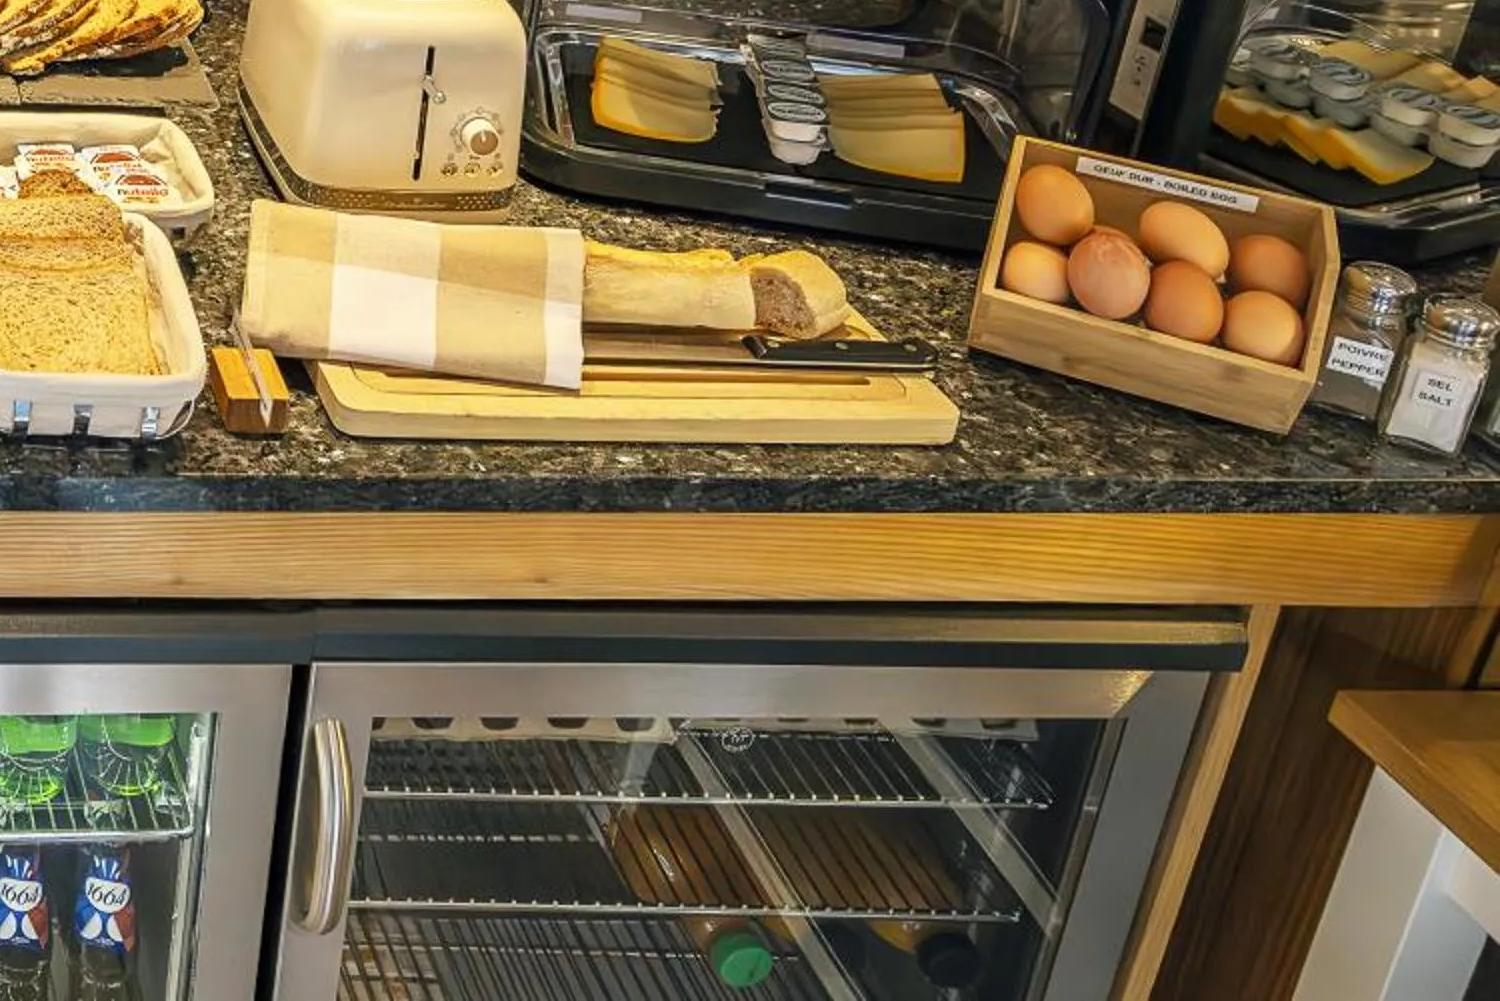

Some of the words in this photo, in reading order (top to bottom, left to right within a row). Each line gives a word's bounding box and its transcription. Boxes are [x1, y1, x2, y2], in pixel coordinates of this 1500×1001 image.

[1129, 170, 1155, 185] DUR
[1162, 178, 1208, 198] BOILED
[1210, 190, 1238, 205] EGG
[1338, 342, 1389, 362] POIVRE
[1332, 358, 1386, 378] PEPPER
[1427, 377, 1453, 392] SEL
[1418, 391, 1453, 407] SALT
[0, 881, 40, 906] 1664
[87, 881, 126, 906] 1664
